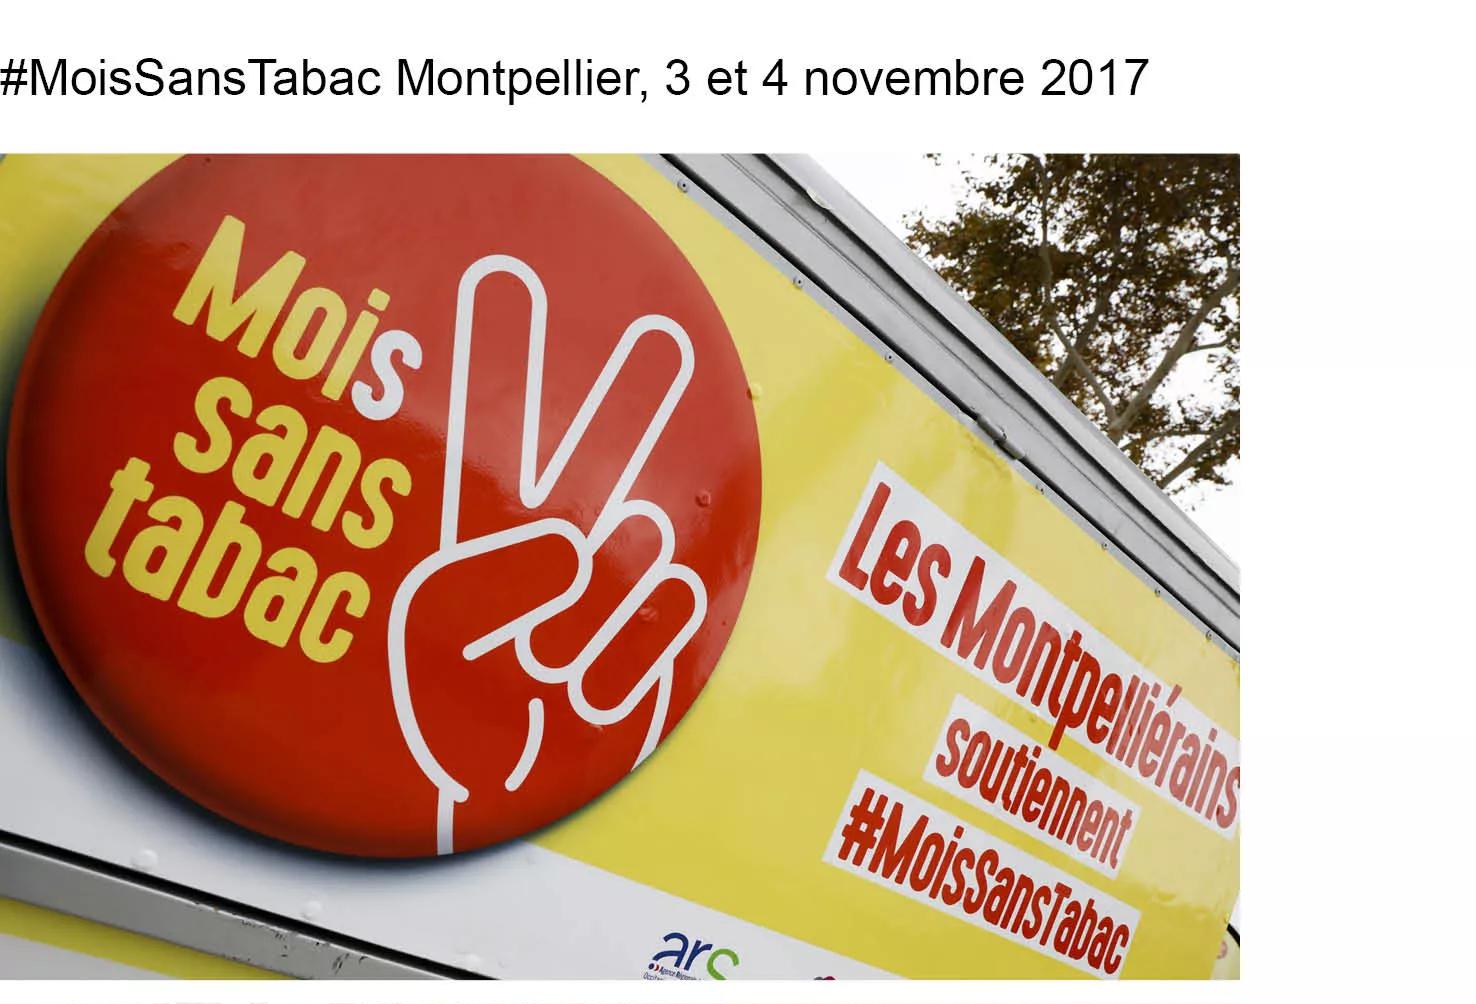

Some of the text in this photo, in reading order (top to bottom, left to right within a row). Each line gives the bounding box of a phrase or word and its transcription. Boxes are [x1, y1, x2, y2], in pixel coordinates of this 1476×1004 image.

[172, 215, 422, 421] Mois
[83, 458, 372, 664] tabac
[173, 376, 412, 550] sans
[838, 481, 1240, 829] Les Montpelliérains
[838, 787, 1130, 975] #MoisSansTabac
[935, 718, 1133, 869] soutiennent
